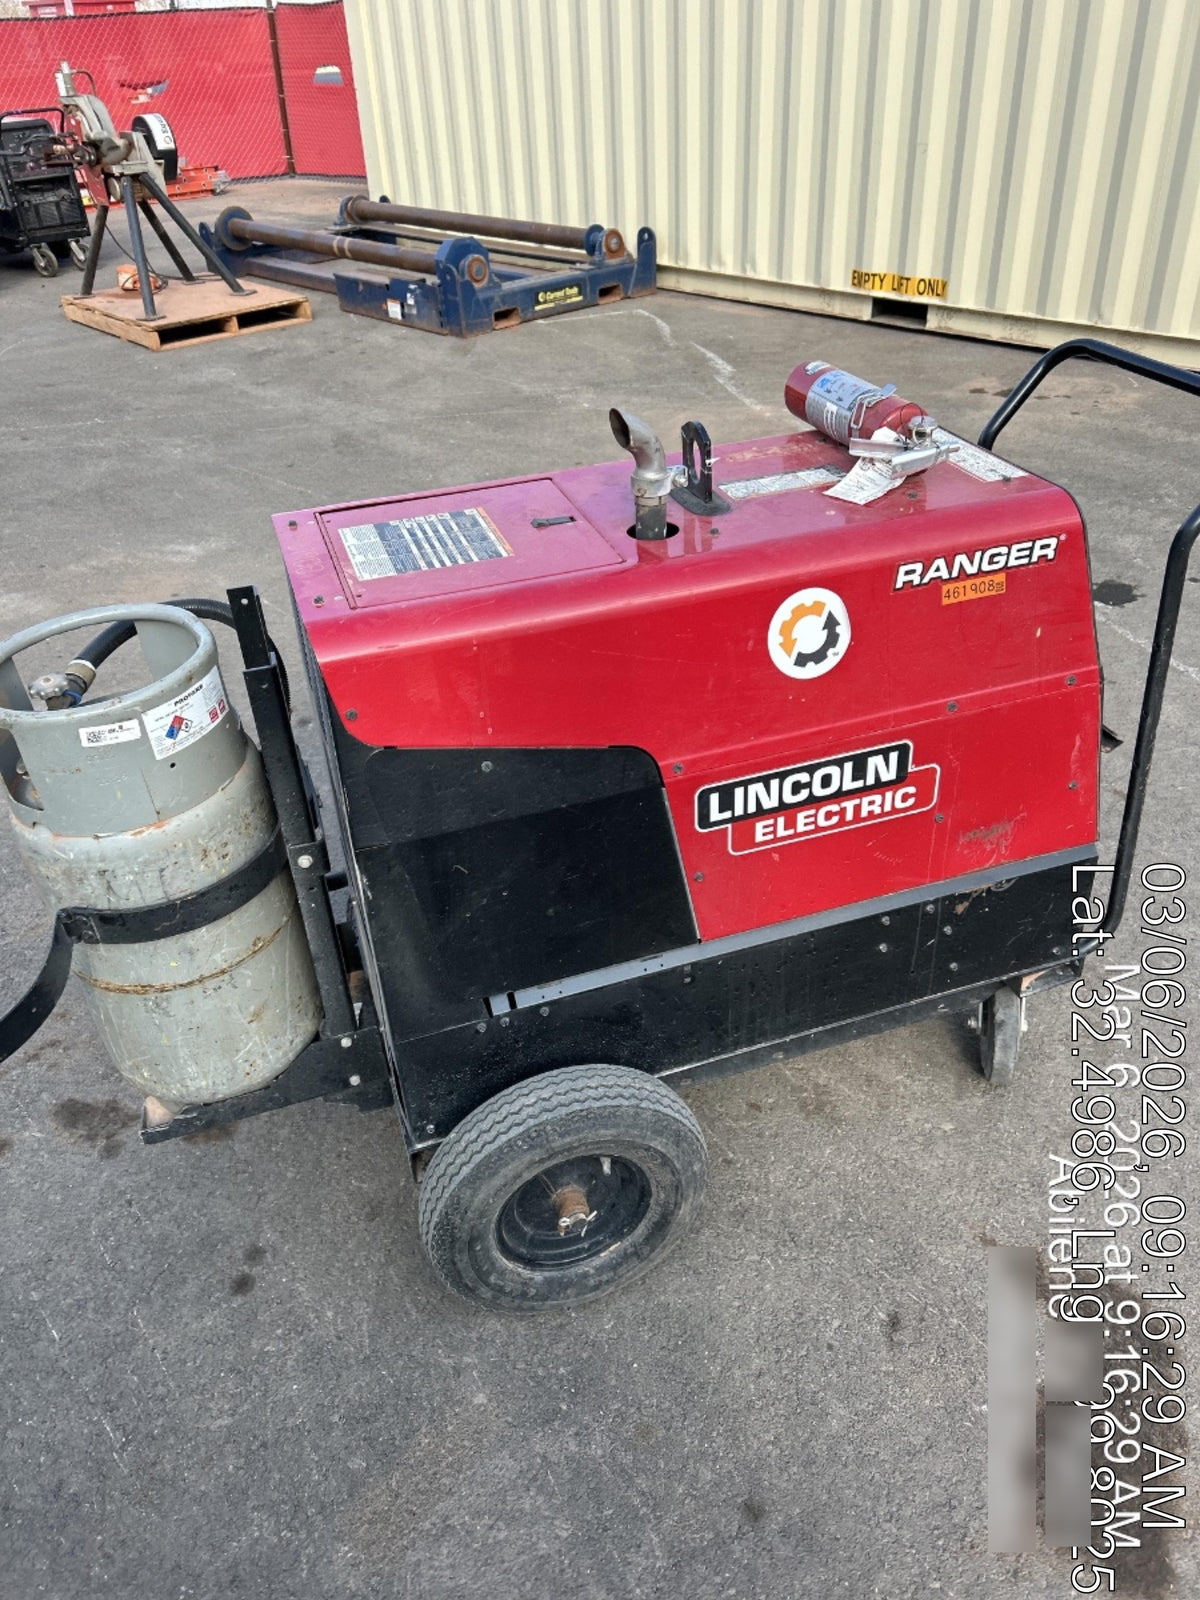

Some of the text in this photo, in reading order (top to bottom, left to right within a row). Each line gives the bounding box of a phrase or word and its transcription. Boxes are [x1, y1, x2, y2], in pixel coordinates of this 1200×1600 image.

[852, 269, 948, 298] EMPTY LIFT ONLY
[893, 535, 1059, 591] RANGER
[943, 579, 995, 601] 461908
[709, 750, 900, 823] LINCOLN
[754, 785, 917, 843] ELECTRIC
